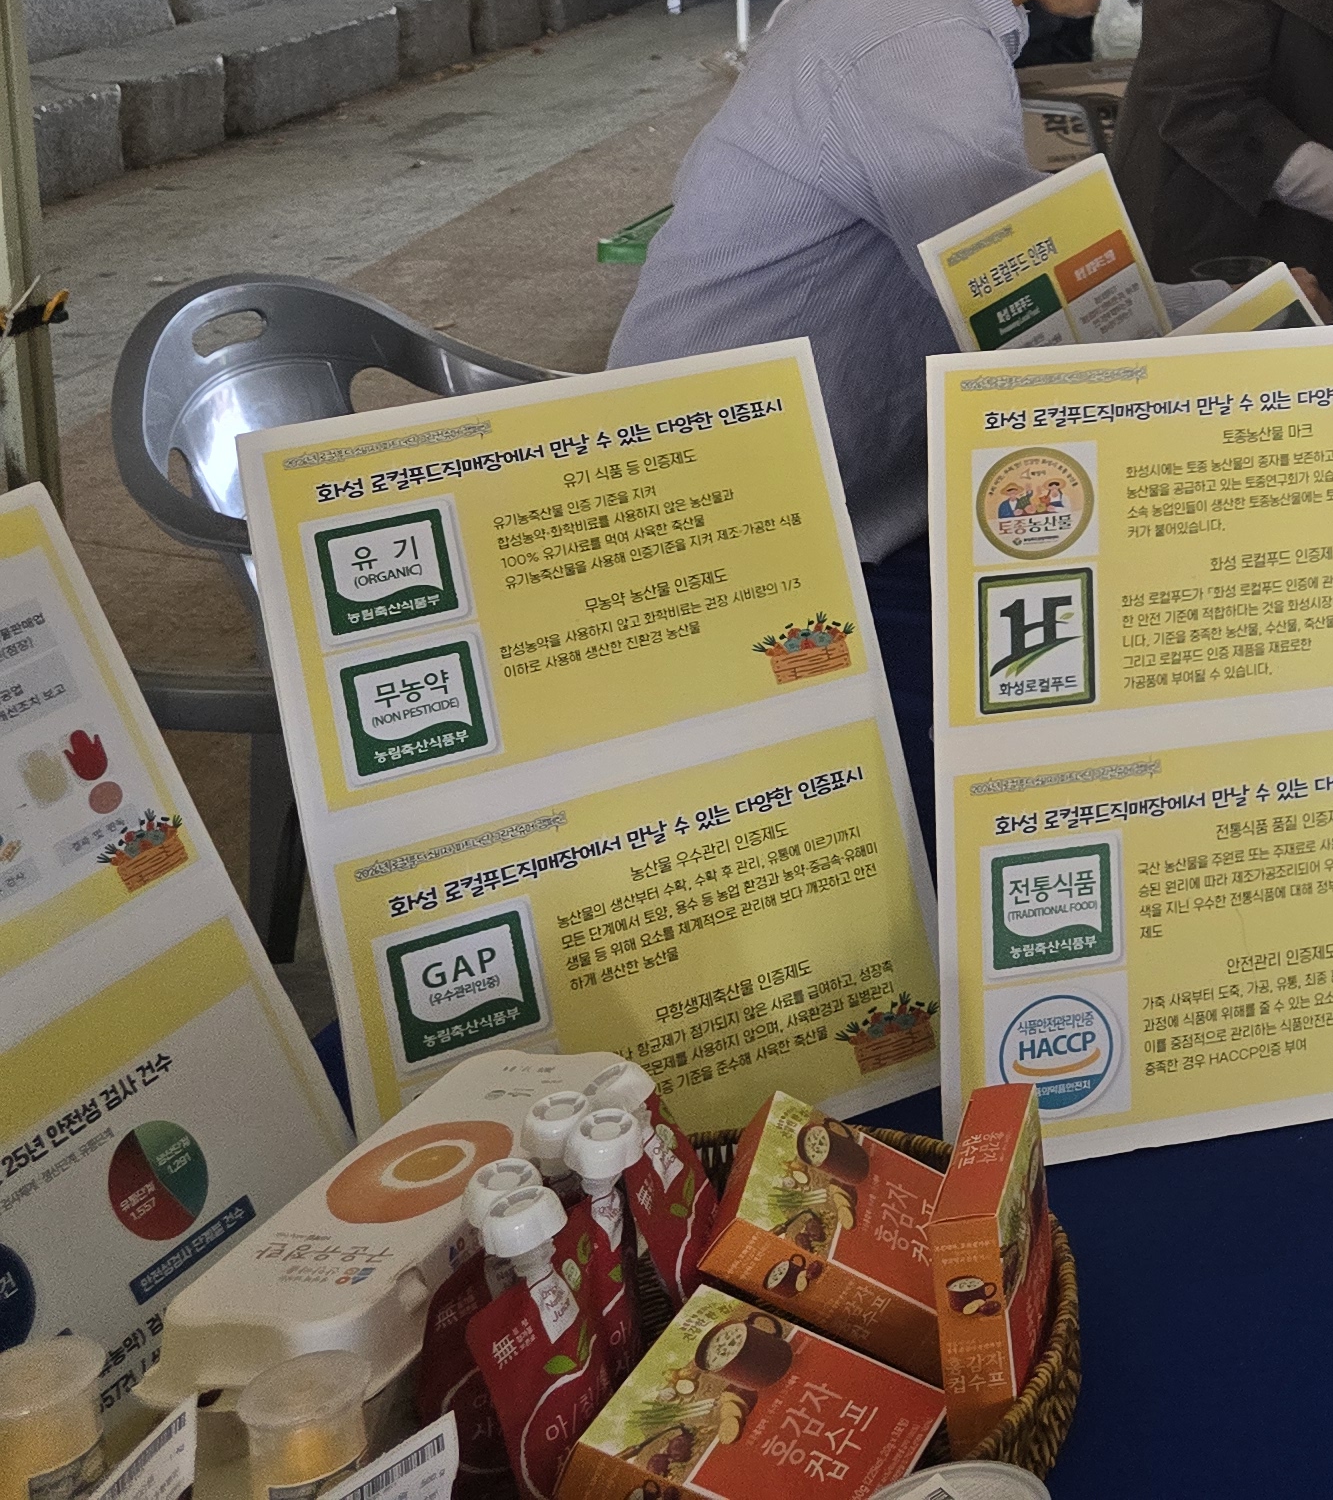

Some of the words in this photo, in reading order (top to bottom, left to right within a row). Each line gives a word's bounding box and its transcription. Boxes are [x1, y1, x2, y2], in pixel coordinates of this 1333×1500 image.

[968, 273, 993, 298] 화성
[989, 251, 1030, 287] 로컬푸드
[1026, 236, 1058, 268] 인증제
[984, 410, 1026, 430] 화성
[1032, 399, 1190, 428] 로컬푸드직매장에서
[1196, 393, 1234, 416] 만날
[1239, 393, 1254, 412] 수
[1259, 390, 1292, 412] 있는
[315, 477, 365, 503] 화성
[370, 444, 545, 494] 로컬푸드직매장에서
[549, 433, 590, 459] 만날
[596, 431, 612, 449] 수
[616, 423, 652, 447] 있는
[656, 411, 714, 434] 다양한
[718, 398, 783, 426] 인증표시
[1222, 425, 1284, 445] 토종농산물
[1287, 423, 1314, 439] 마크
[563, 469, 591, 489] 유기
[595, 463, 623, 481] 식품
[626, 459, 640, 476] 등
[643, 448, 698, 473] 인증제도
[1126, 483, 1170, 500] 농산물을
[1173, 478, 1217, 496] 공급하고
[1219, 477, 1242, 492] 있는
[1245, 470, 1310, 490] 토종연구회가
[493, 503, 564, 531] 유기농축산물
[566, 498, 592, 515] 인증
[594, 490, 629, 508] 기준을
[632, 485, 657, 500] 지켜
[998, 513, 1072, 535] 토종농산물
[350, 546, 378, 572] 유
[393, 535, 419, 560] 기
[500, 552, 540, 569] 100%
[542, 536, 602, 561] 유기사료를
[604, 530, 630, 546] 먹여
[633, 522, 668, 540] 사육한
[671, 514, 705, 532] 축산물
[504, 560, 587, 590] 유기농축산물을
[590, 551, 627, 570] 사용해
[629, 538, 687, 563] 인증기준을
[689, 532, 714, 547] 지켜
[716, 518, 776, 541] 제조·가공한
[779, 512, 802, 527] 식품
[1209, 555, 1237, 572] 화성
[1241, 549, 1292, 569] 로컬푸드
[1294, 546, 1333, 565] 인증제
[353, 563, 423, 589] (ORGANIC)
[584, 591, 626, 614] 무농약
[629, 581, 670, 604] 농산물
[674, 567, 728, 594] 인증제도
[347, 593, 440, 624] 농림축산식품부
[503, 659, 542, 678] 이하로
[545, 649, 582, 669] 사용해
[585, 639, 623, 660] 생산한
[626, 629, 664, 651] 친환경
[665, 620, 701, 641] 농산물
[374, 669, 450, 709] 무농약
[998, 675, 1078, 697] 화성로컬푸드
[371, 710, 402, 728] (NON
[402, 696, 460, 720] PESTICIDE)
[373, 729, 469, 764] 농림축산식품부
[995, 812, 1038, 836] 화성
[1044, 792, 1206, 830] 로컬푸드직매장에서
[1211, 784, 1250, 809] 만날
[1255, 783, 1271, 803] 수
[1276, 777, 1309, 802] 있는
[388, 886, 439, 918] 화성
[444, 835, 622, 903] 로컬푸드직매장에서
[626, 820, 668, 850] 만날
[674, 816, 690, 835] 수
[695, 804, 731, 831] 있는
[735, 785, 793, 815] 다양한
[797, 766, 864, 800] 인증표시
[1215, 818, 1268, 841] 전통식품
[1272, 814, 1297, 833] 품질
[630, 856, 672, 882] 농산물
[676, 838, 731, 868] 우수관리
[734, 821, 790, 851] 인증제도
[556, 902, 607, 929] 농산물의
[610, 886, 660, 913] 생산부터
[663, 878, 692, 897] 수확,
[694, 868, 718, 887] 수확
[721, 864, 734, 879] 후
[735, 855, 765, 875] 관리,
[767, 843, 802, 866] 유통에
[803, 825, 861, 853] 이르기까지
[1008, 869, 1097, 906] 전통식품
[1007, 904, 1069, 923] (TRADITIONAL
[1069, 900, 1098, 913] FOOD)
[421, 947, 497, 989] GAP
[569, 972, 598, 991] 하게
[600, 958, 640, 983] 생산한
[642, 946, 679, 970] 농산물
[1226, 951, 1281, 975] 안전관리
[428, 974, 501, 1007] (우수관리인증)
[655, 978, 754, 1024] 무항생제축산물
[757, 959, 813, 991] 인증제도
[422, 1006, 521, 1048] 농림축산식품부
[1015, 1008, 1096, 1036] 식품안전관리인증
[1018, 1030, 1099, 1062] HACCP
[47, 1097, 102, 1150] 안전성
[99, 1076, 138, 1113] 검사
[136, 1052, 174, 1086] 건수
[872, 1180, 919, 1251] 홍감자
[948, 1370, 1009, 1395] 컵수프
[761, 1380, 843, 1467] 홍감자
[804, 1399, 879, 1483] 컵수프
